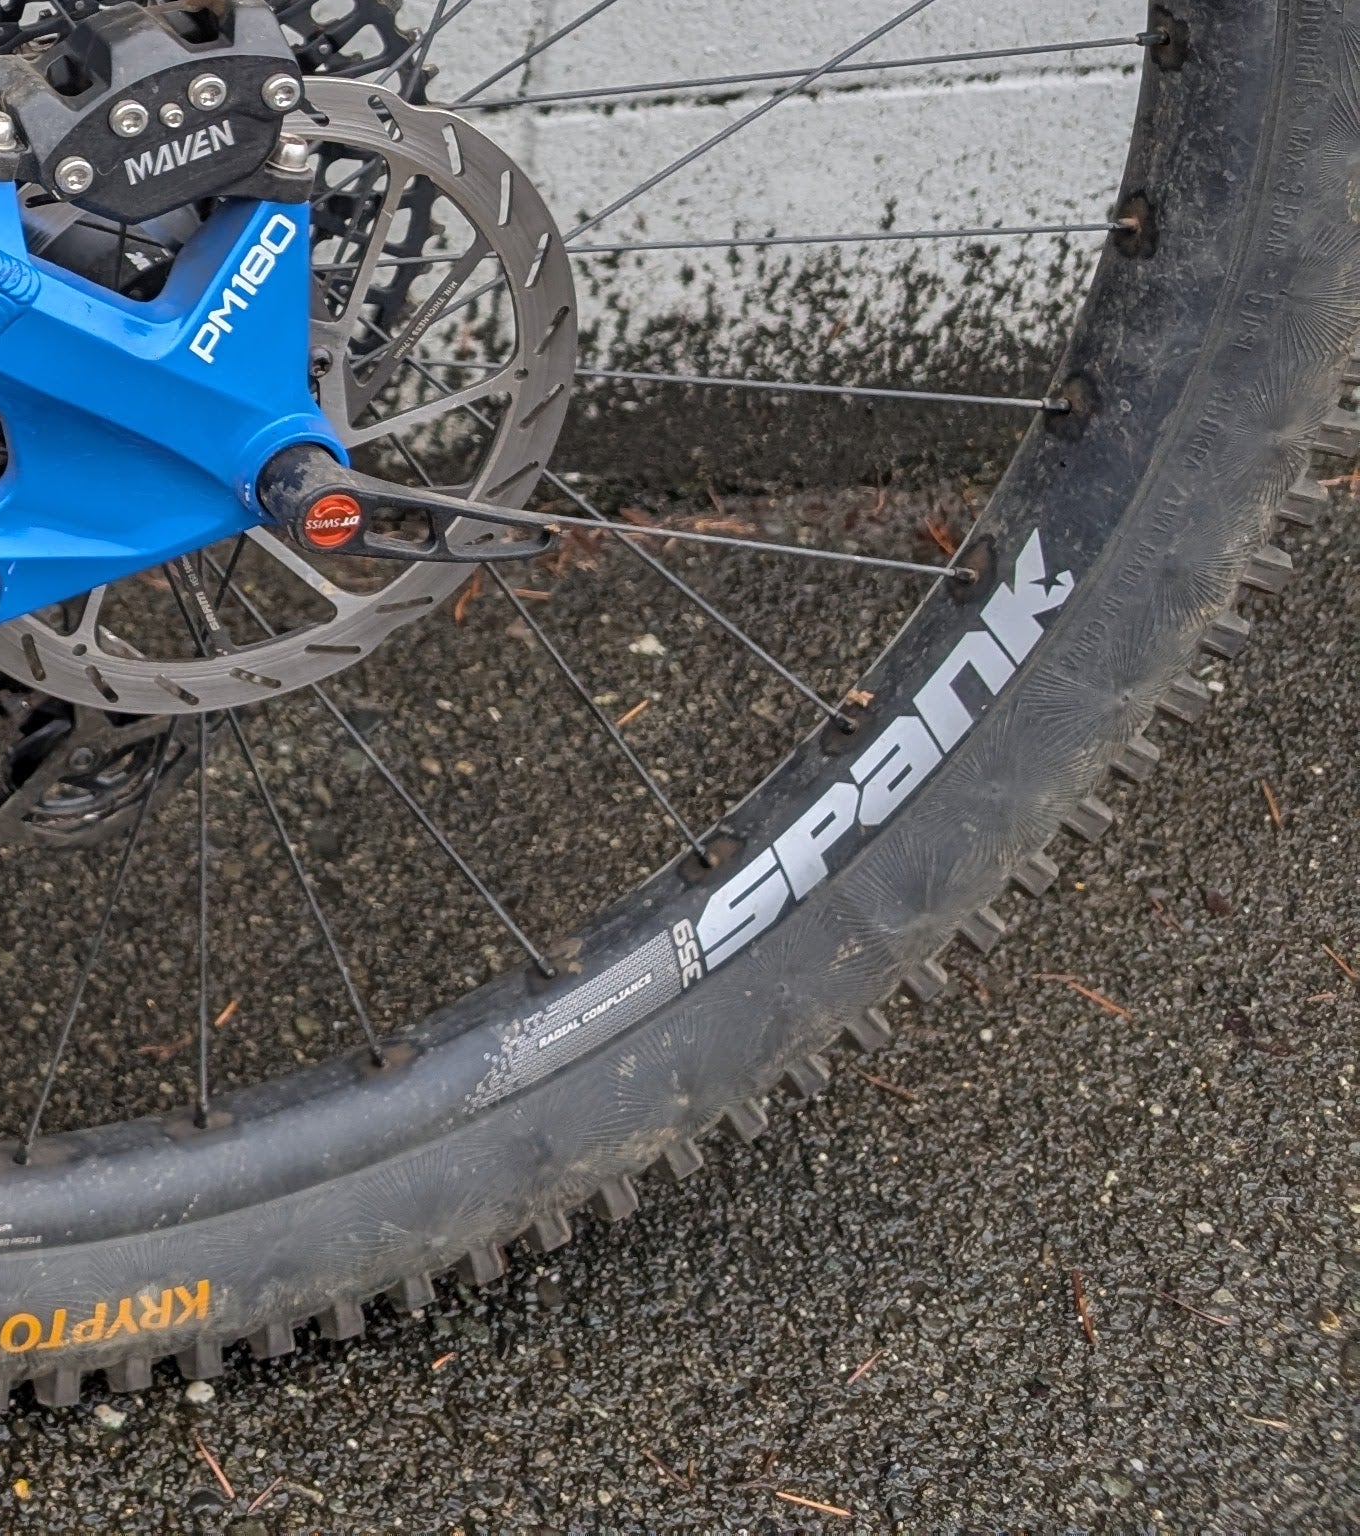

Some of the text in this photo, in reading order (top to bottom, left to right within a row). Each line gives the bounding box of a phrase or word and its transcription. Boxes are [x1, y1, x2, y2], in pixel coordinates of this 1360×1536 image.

[123, 118, 236, 187] MAVEN
[188, 213, 298, 365] PM180
[411, 296, 445, 337] THICKNESS
[305, 515, 360, 530] DT SWISS
[672, 918, 703, 989] 359
[538, 972, 654, 1050] RADIAL COMPLIANCE
